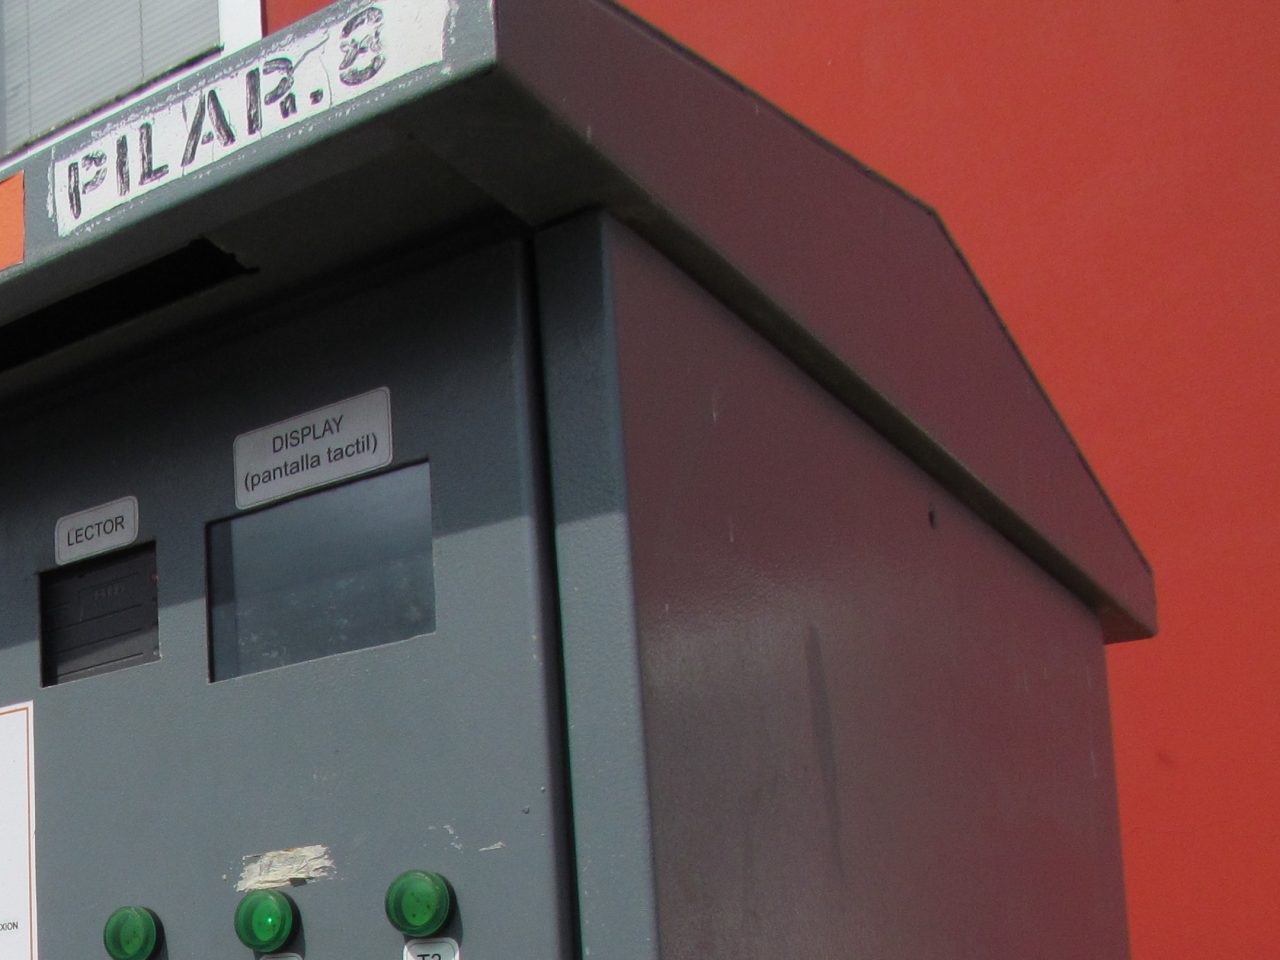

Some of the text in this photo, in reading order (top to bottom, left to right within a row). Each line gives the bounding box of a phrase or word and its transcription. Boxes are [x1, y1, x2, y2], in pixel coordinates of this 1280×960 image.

[272, 415, 344, 454] DISPLAY
[243, 432, 378, 492] (pantalla tactil)
[67, 516, 125, 547] LECTOR
